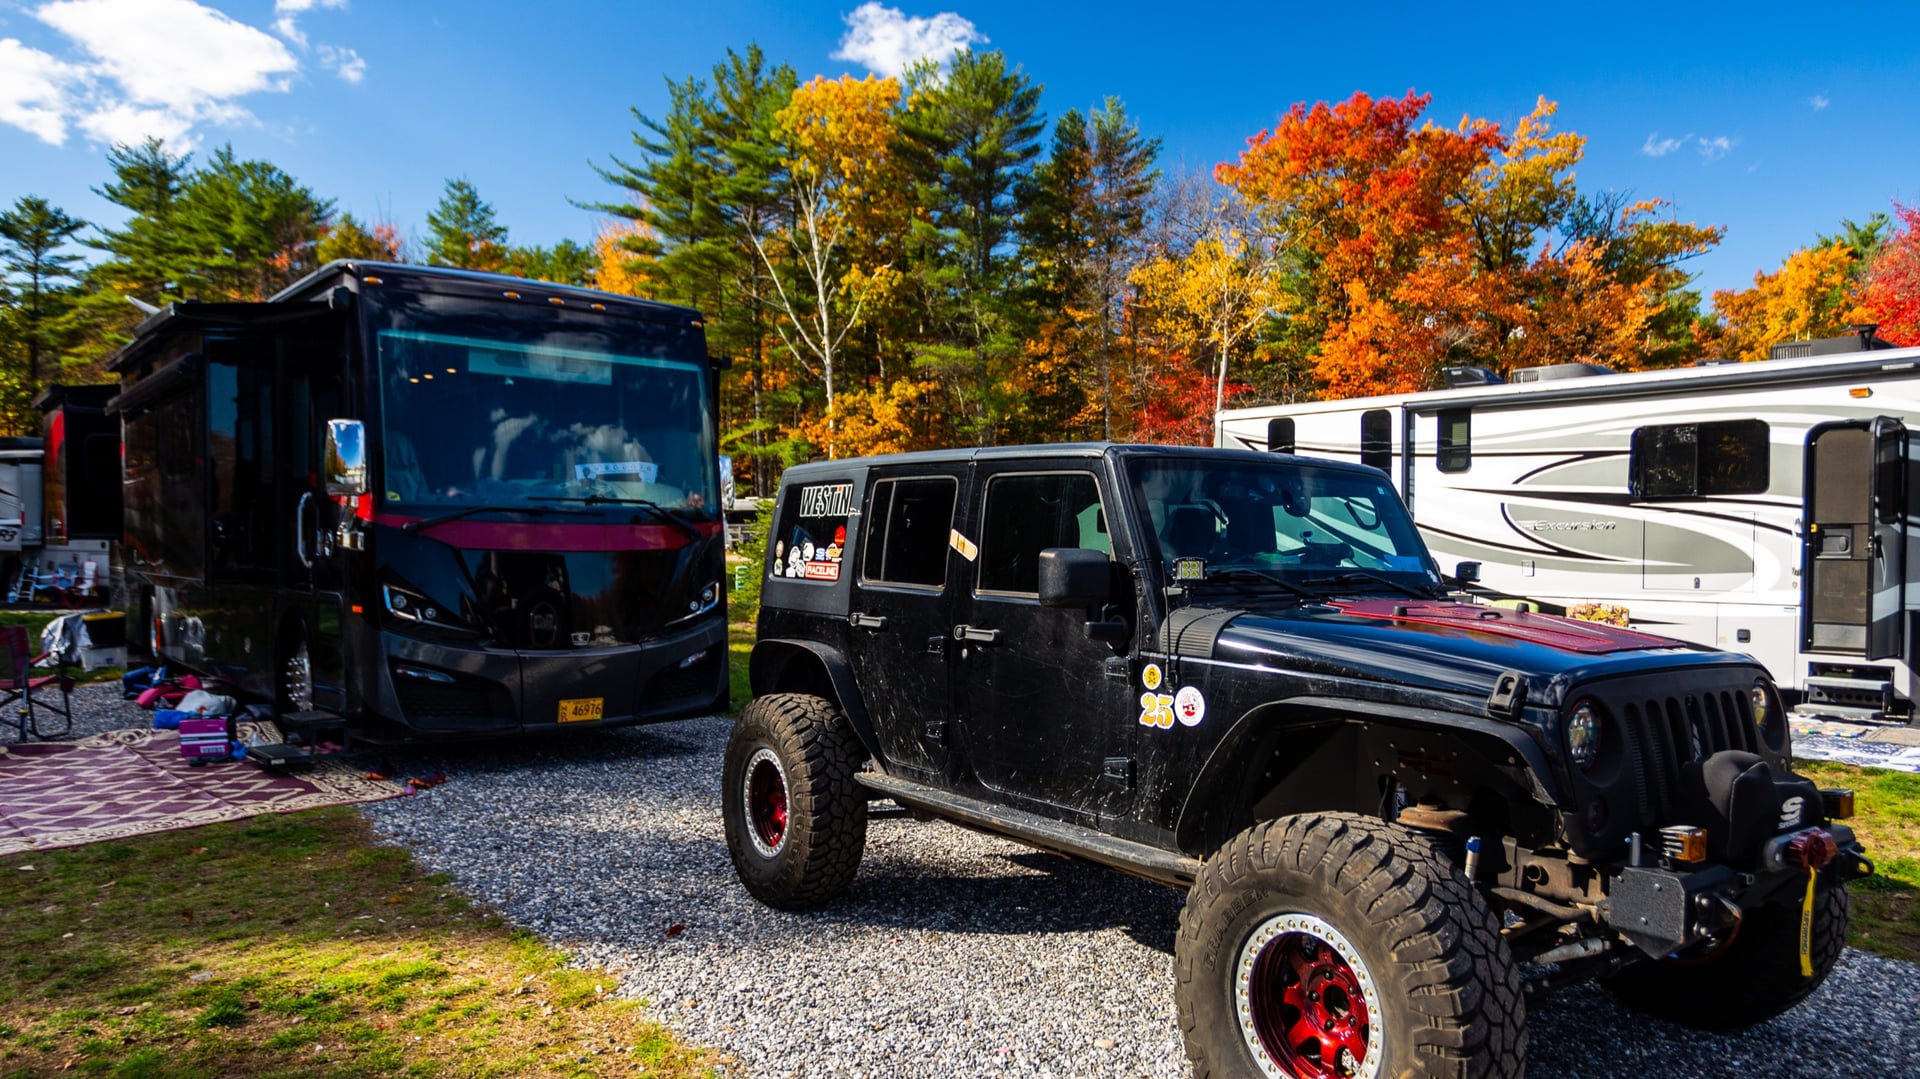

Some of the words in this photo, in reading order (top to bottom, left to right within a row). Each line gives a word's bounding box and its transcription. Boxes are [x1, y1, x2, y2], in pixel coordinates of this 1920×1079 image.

[1533, 520, 1616, 531] Excursion
[806, 563, 838, 577] RACELINE
[572, 703, 601, 716] 46976
[1139, 692, 1175, 729] 25
